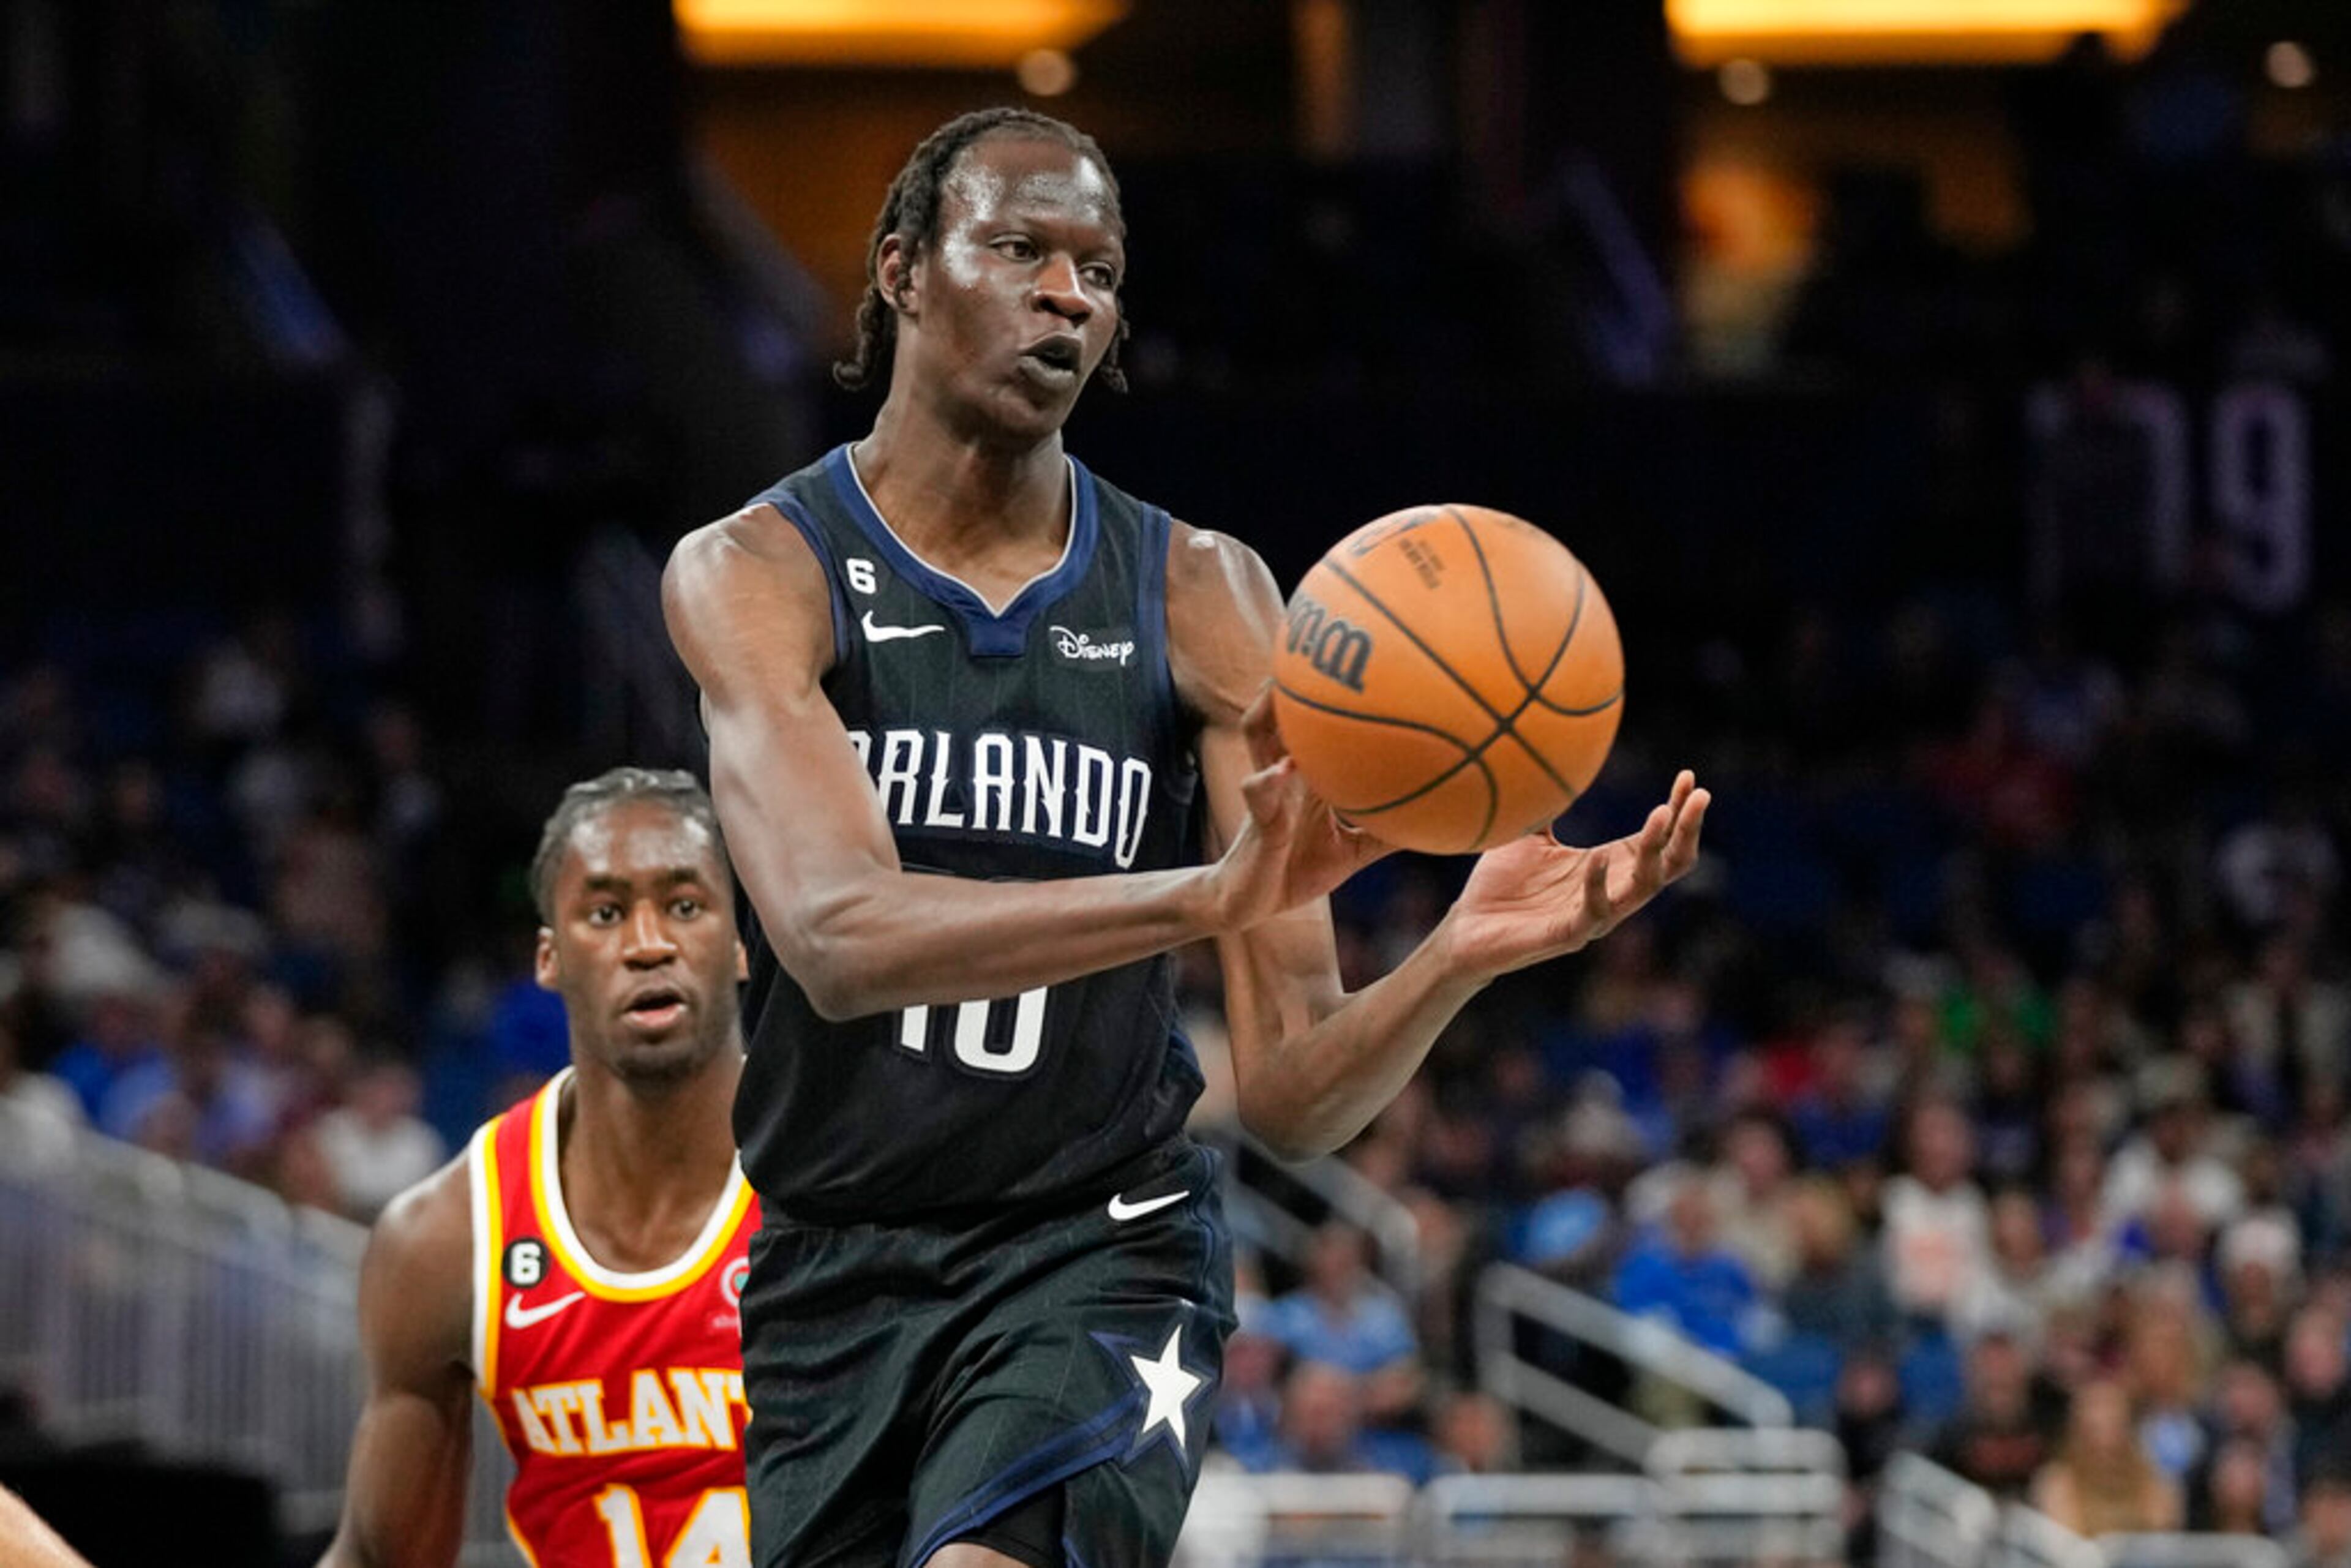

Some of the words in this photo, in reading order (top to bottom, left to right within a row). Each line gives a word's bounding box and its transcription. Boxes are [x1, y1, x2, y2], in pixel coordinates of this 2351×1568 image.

[846, 558, 876, 595] 6
[1049, 625, 1134, 666] Disney
[511, 1241, 541, 1283] 6
